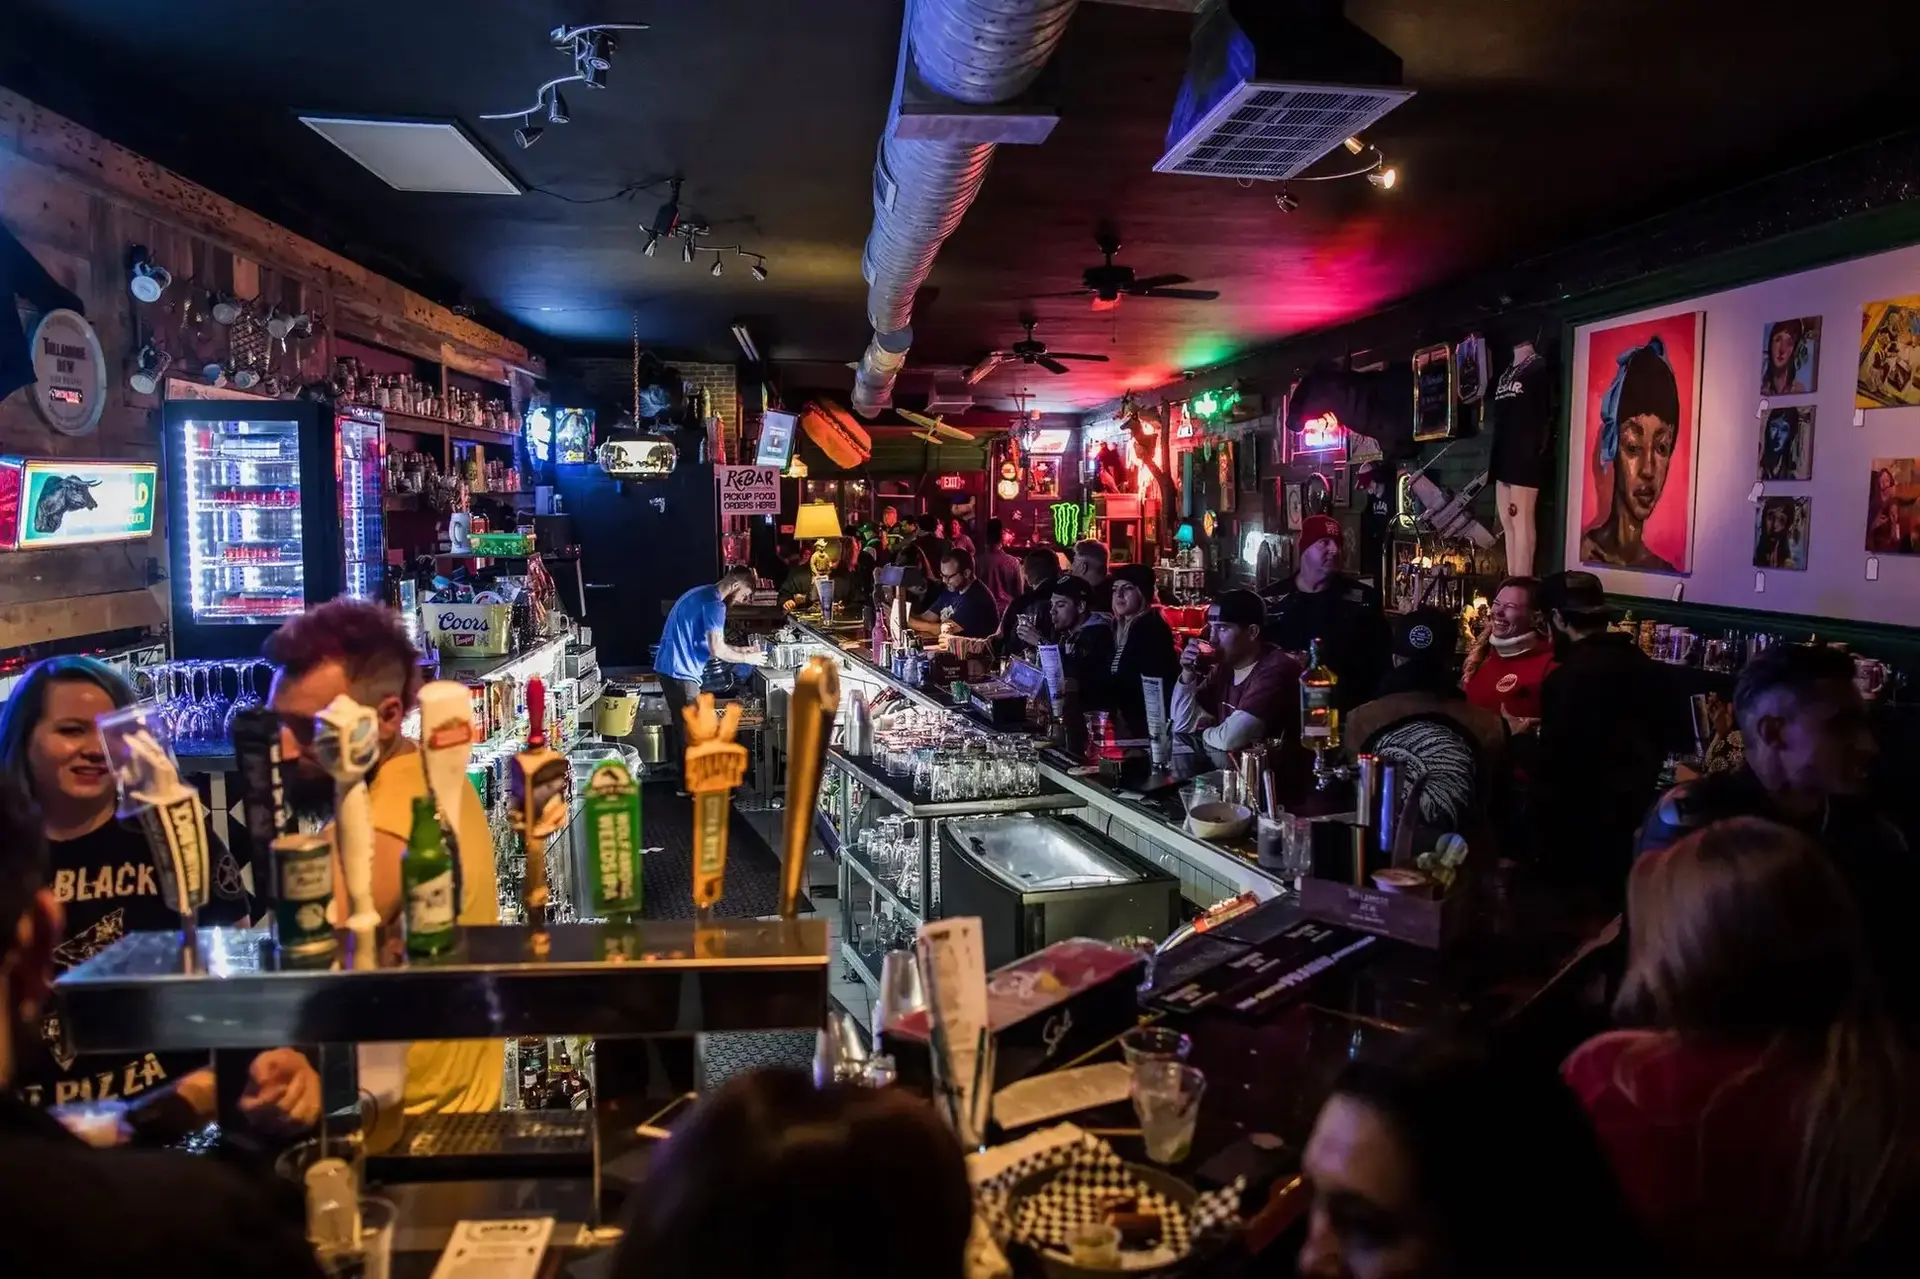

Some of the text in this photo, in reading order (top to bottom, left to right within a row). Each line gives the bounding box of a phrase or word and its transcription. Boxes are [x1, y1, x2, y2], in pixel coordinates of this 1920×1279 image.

[944, 476, 958, 488] EXIT
[724, 492, 776, 501] PICKUP FOOD
[724, 501, 776, 510] ORDERS HERE!
[438, 612, 490, 631] Coors
[54, 861, 158, 903] BLACK
[56, 1052, 168, 1106] PIZZA
